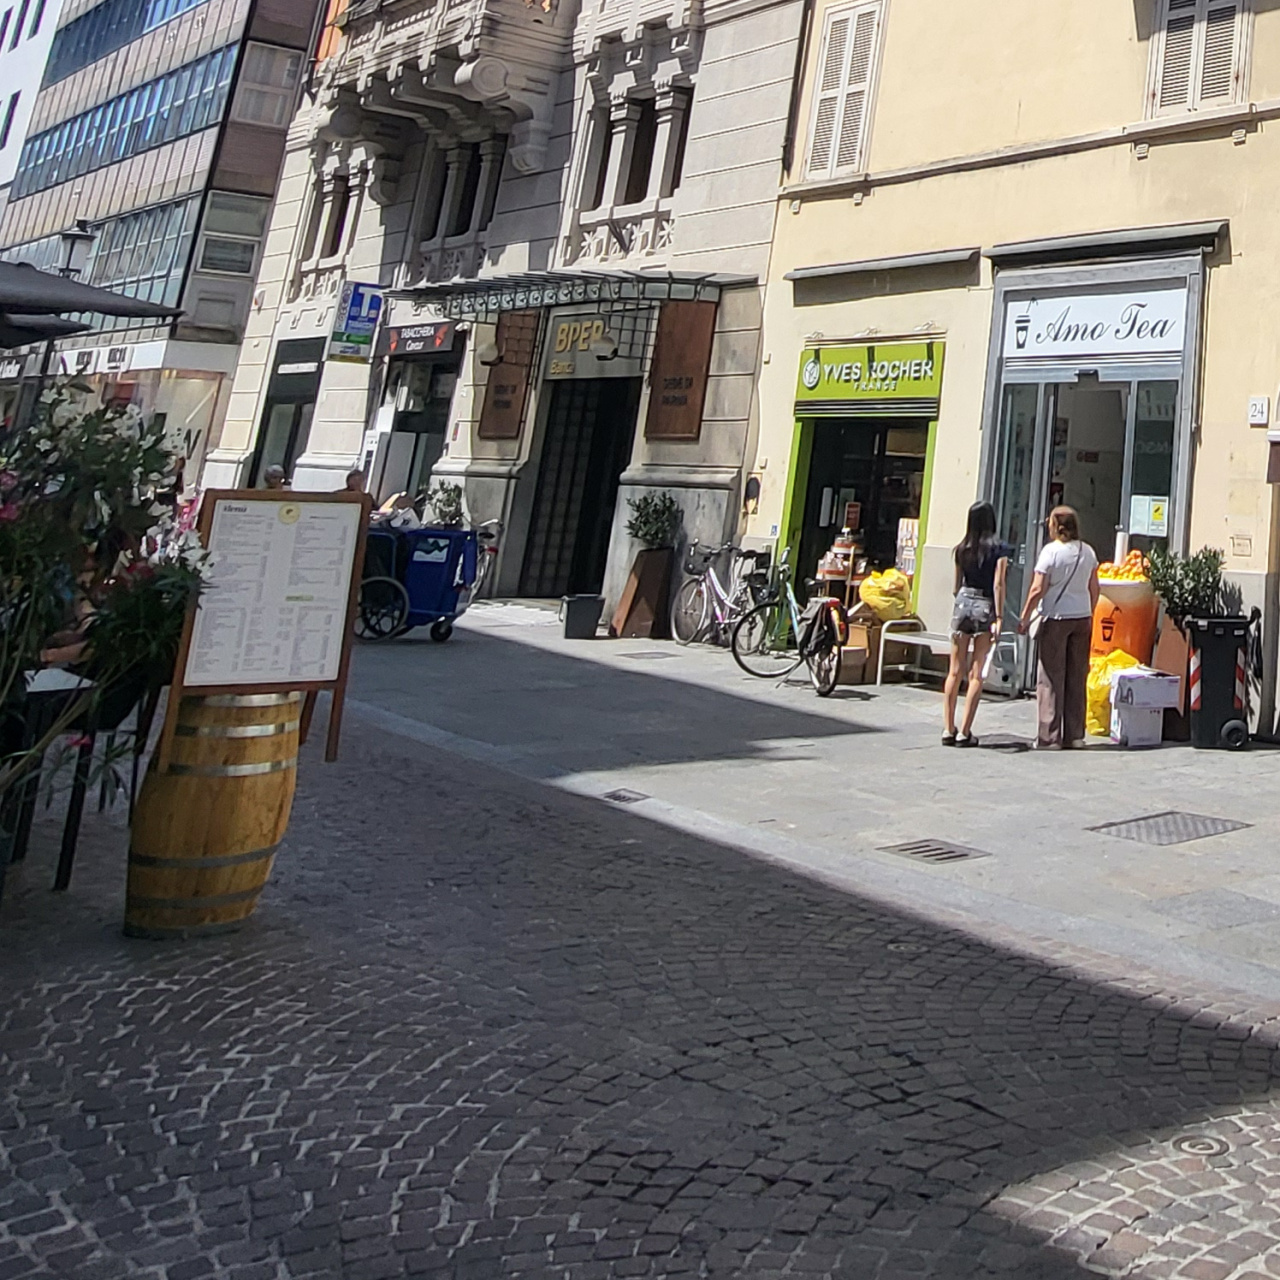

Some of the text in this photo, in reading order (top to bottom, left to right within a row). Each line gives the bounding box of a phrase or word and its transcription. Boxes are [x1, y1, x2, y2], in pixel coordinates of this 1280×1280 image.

[1035, 302, 1177, 345] Amo Tea
[823, 359, 934, 381] YVES ROCHER
[854, 380, 897, 391] FRANCE
[1250, 402, 1265, 418] 24
